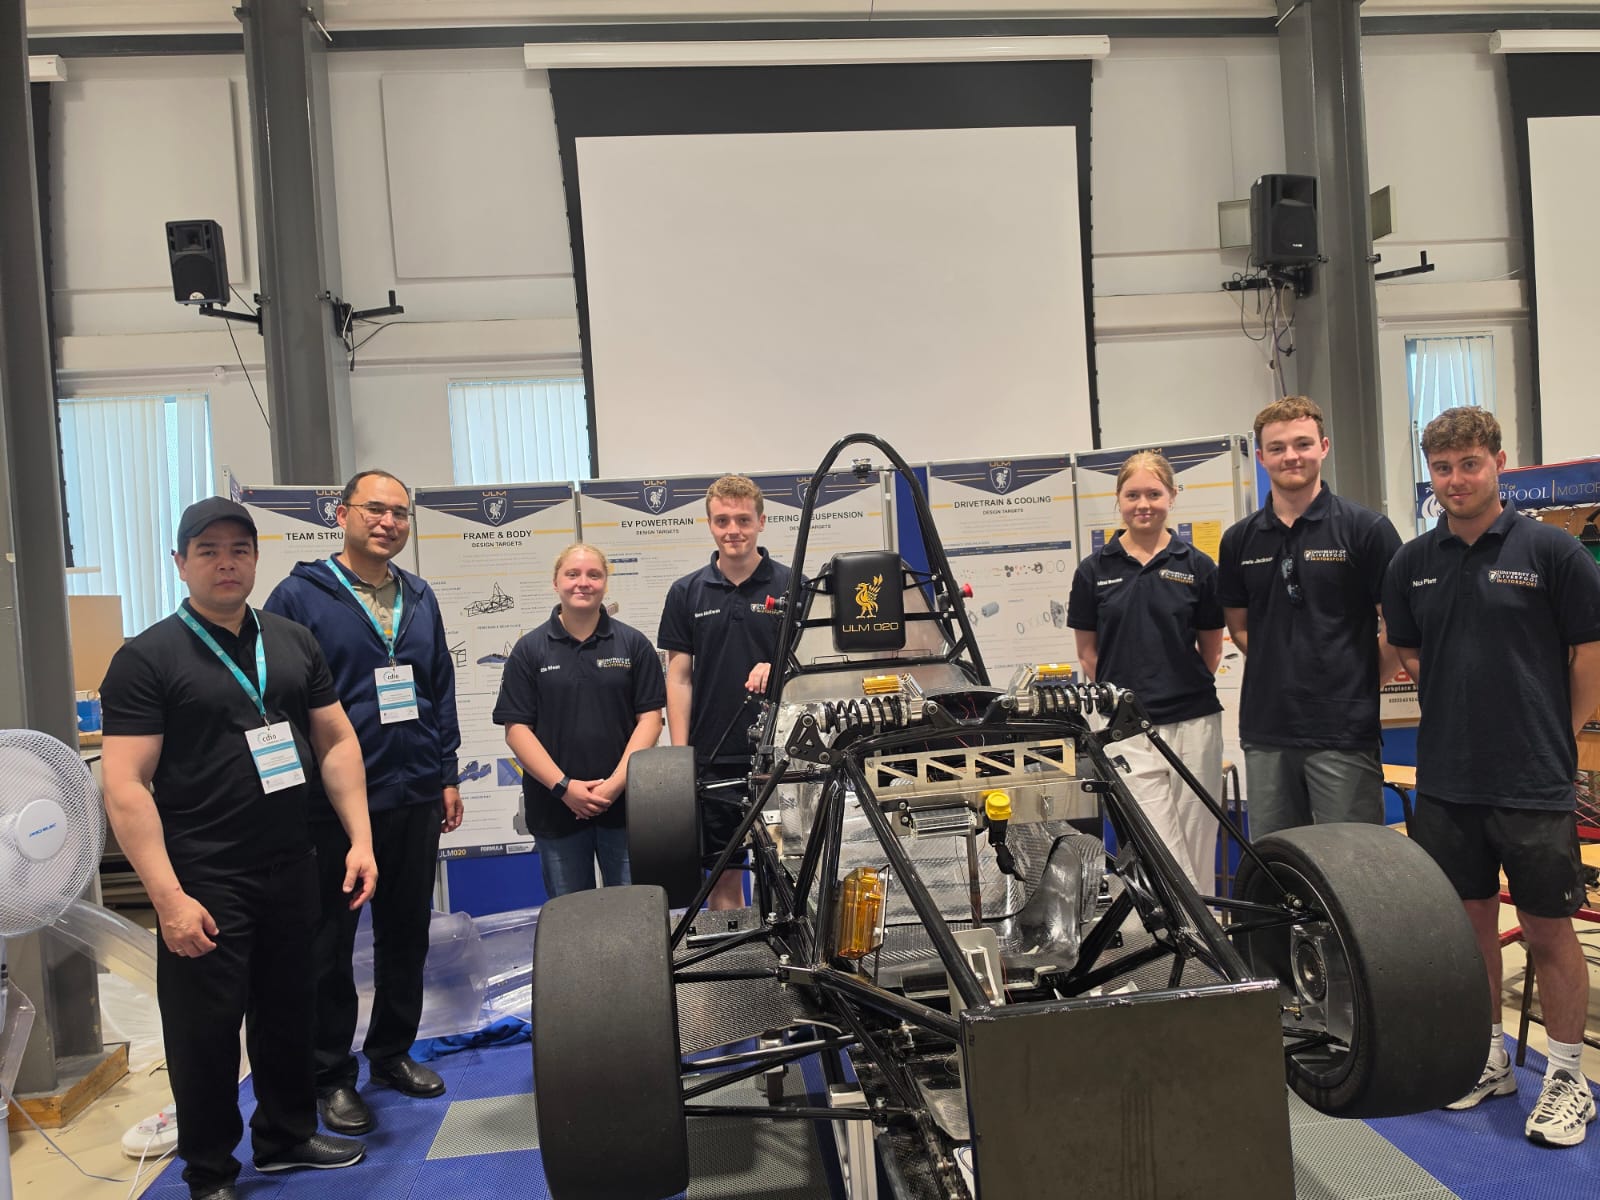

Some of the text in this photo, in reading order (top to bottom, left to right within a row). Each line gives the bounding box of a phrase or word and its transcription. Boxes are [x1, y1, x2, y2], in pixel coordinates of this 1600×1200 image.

[1499, 486, 1550, 501] RPOOL
[954, 498, 1004, 509] DRIVETRAIN
[1014, 495, 1052, 505] COOLING
[767, 511, 864, 523] EERING SUSPENSION
[621, 518, 694, 528] EV POWERTRAIN
[285, 531, 344, 541] TEAM STRU
[463, 530, 532, 540] FRAME & BODY
[495, 540, 523, 548] TARGETS
[842, 623, 870, 633] ULM
